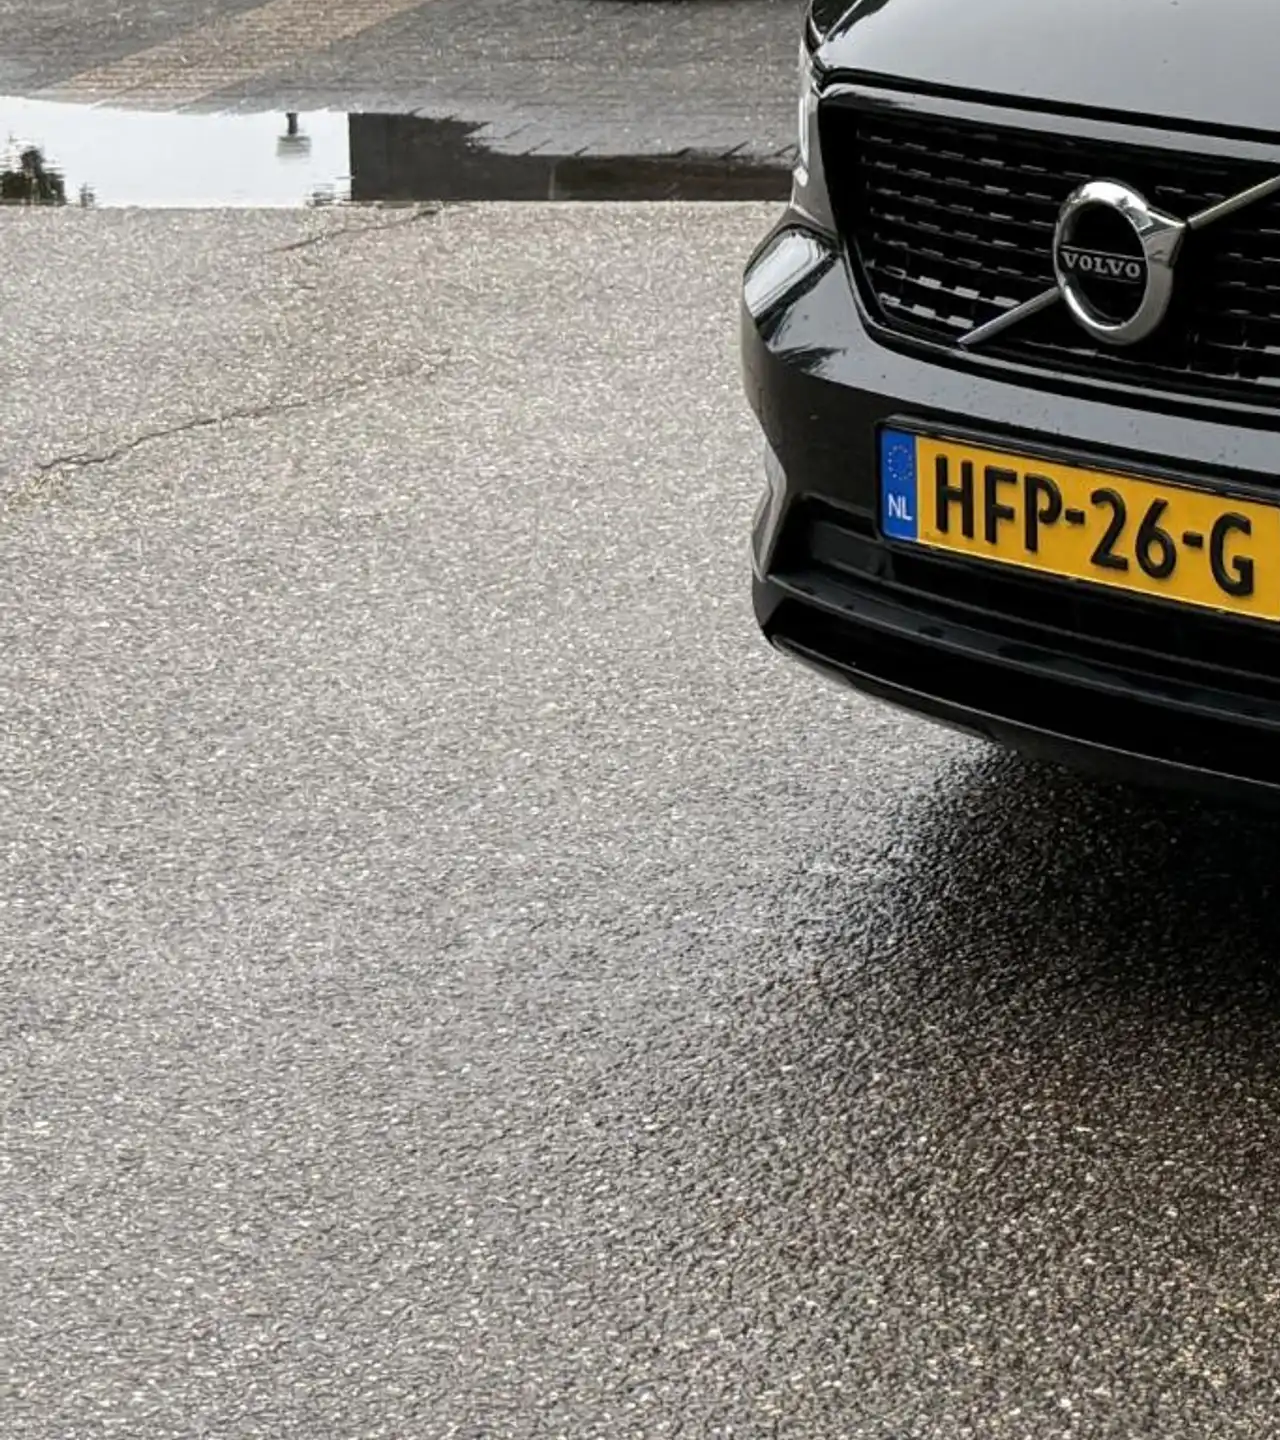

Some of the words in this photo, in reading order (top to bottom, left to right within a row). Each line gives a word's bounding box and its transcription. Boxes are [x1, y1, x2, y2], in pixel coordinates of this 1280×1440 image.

[1061, 252, 1140, 277] VOLVO
[888, 494, 913, 521] NL
[935, 454, 1254, 597] HFP-26-G
